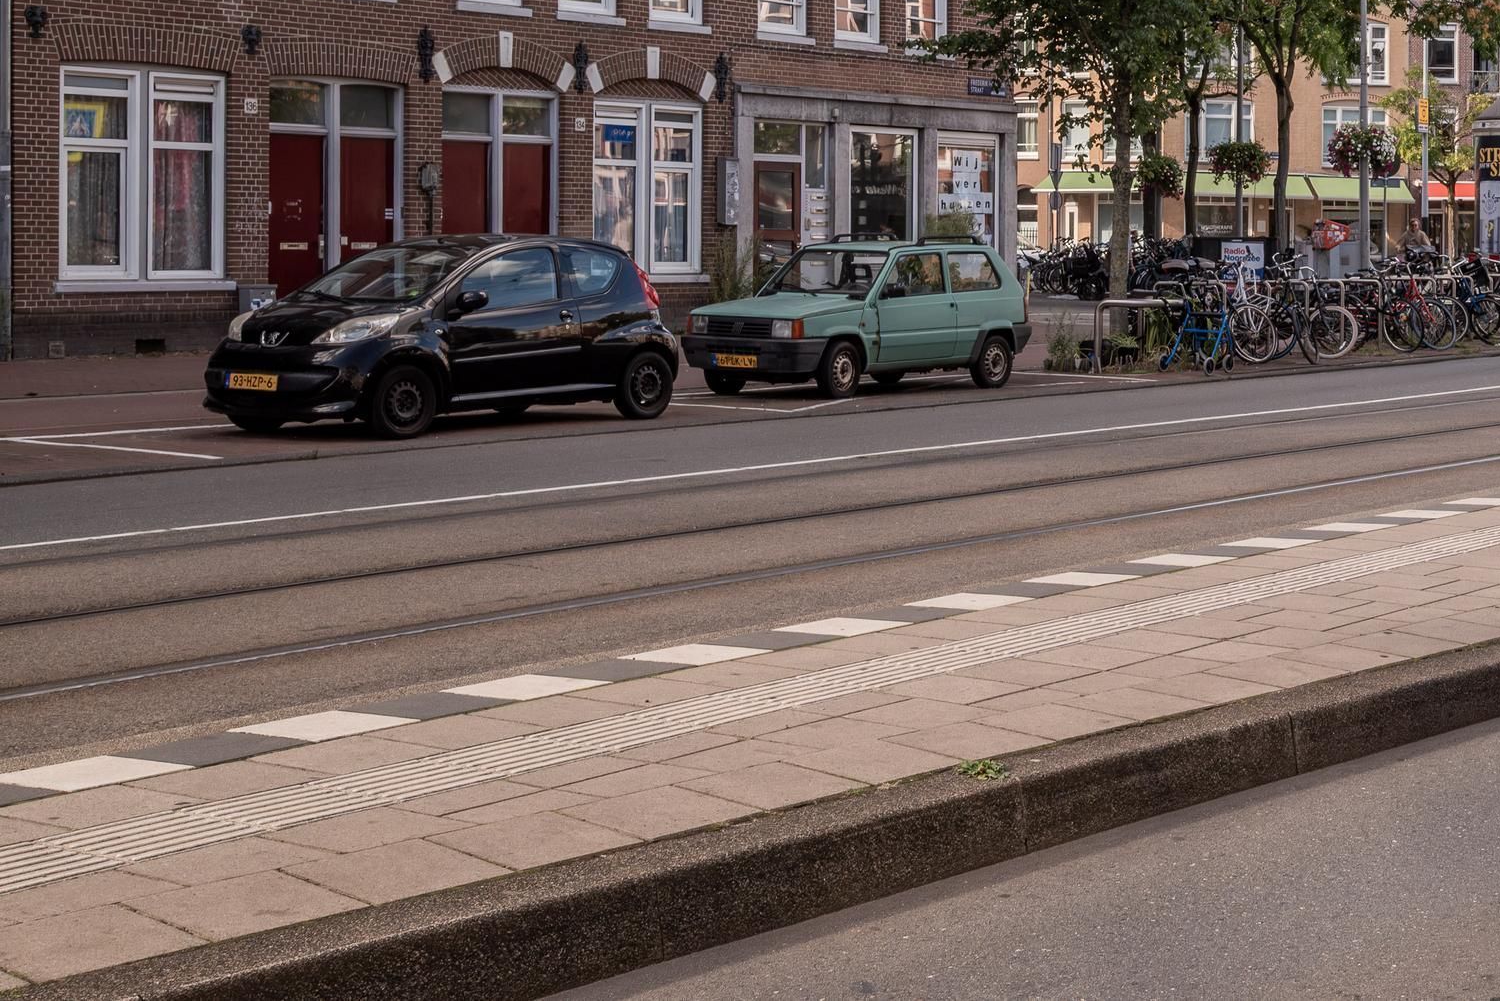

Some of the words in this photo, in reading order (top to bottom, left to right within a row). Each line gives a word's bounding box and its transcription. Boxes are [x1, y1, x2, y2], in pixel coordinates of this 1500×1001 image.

[954, 156, 978, 170] Wij
[955, 180, 977, 189] ver
[1224, 247, 1246, 255] Radio
[233, 374, 273, 389] 93-HZP-6
